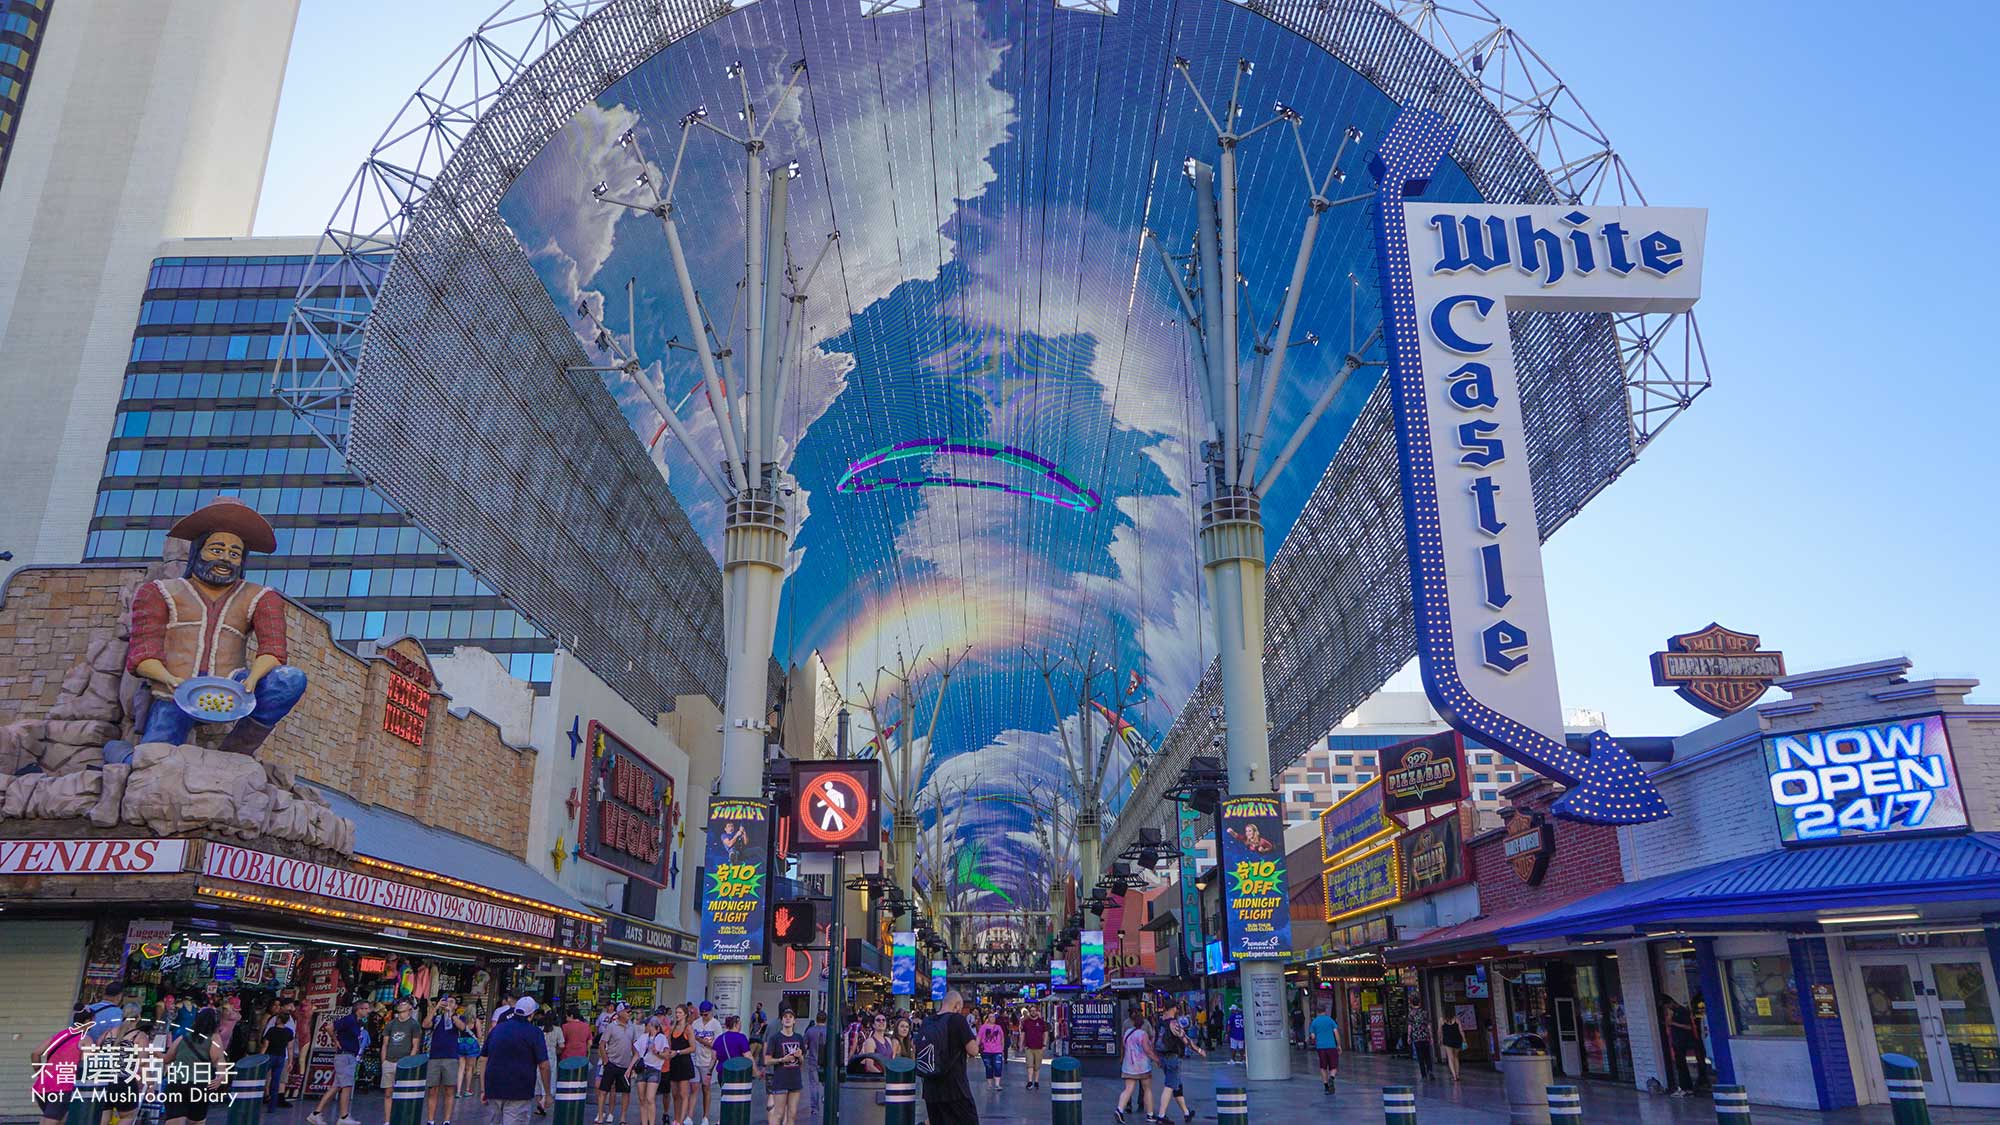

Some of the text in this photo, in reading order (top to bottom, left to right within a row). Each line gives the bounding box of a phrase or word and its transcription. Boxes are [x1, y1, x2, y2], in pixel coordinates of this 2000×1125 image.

[1429, 211, 1685, 288] White
[1428, 295, 1529, 675] Castle
[1692, 632, 1748, 652] MOTOR
[1776, 724, 1922, 769] NOW
[1389, 768, 1424, 790] PIZZA
[1424, 763, 1451, 781] BAR
[1770, 755, 1946, 806] OPEN
[1793, 791, 1934, 840] 24/7
[717, 864, 756, 881] $10
[1237, 861, 1276, 879] $10
[215, 845, 318, 893] TOBACCO
[369, 878, 440, 919] T-SHIRTS
[465, 900, 527, 930] SOUVENIRS
[529, 921, 556, 938] BEER
[720, 882, 752, 898] OFF
[1241, 880, 1273, 895] OFF
[708, 901, 758, 911] MIDNIGHT
[1232, 898, 1282, 908] MIDNIGHT
[713, 912, 748, 923] FLIGHT
[1239, 909, 1273, 920] FLIGHT
[128, 928, 170, 939] Luggage
[624, 925, 643, 943] HATS
[646, 930, 673, 950] LIQUOR
[702, 953, 761, 961] VegasExperience.com
[763, 945, 813, 984] the D
[247, 962, 260, 978] 99
[634, 966, 671, 977] LIQUOR
[1086, 1003, 1113, 1014] MILLION
[313, 1069, 334, 1084] 99
